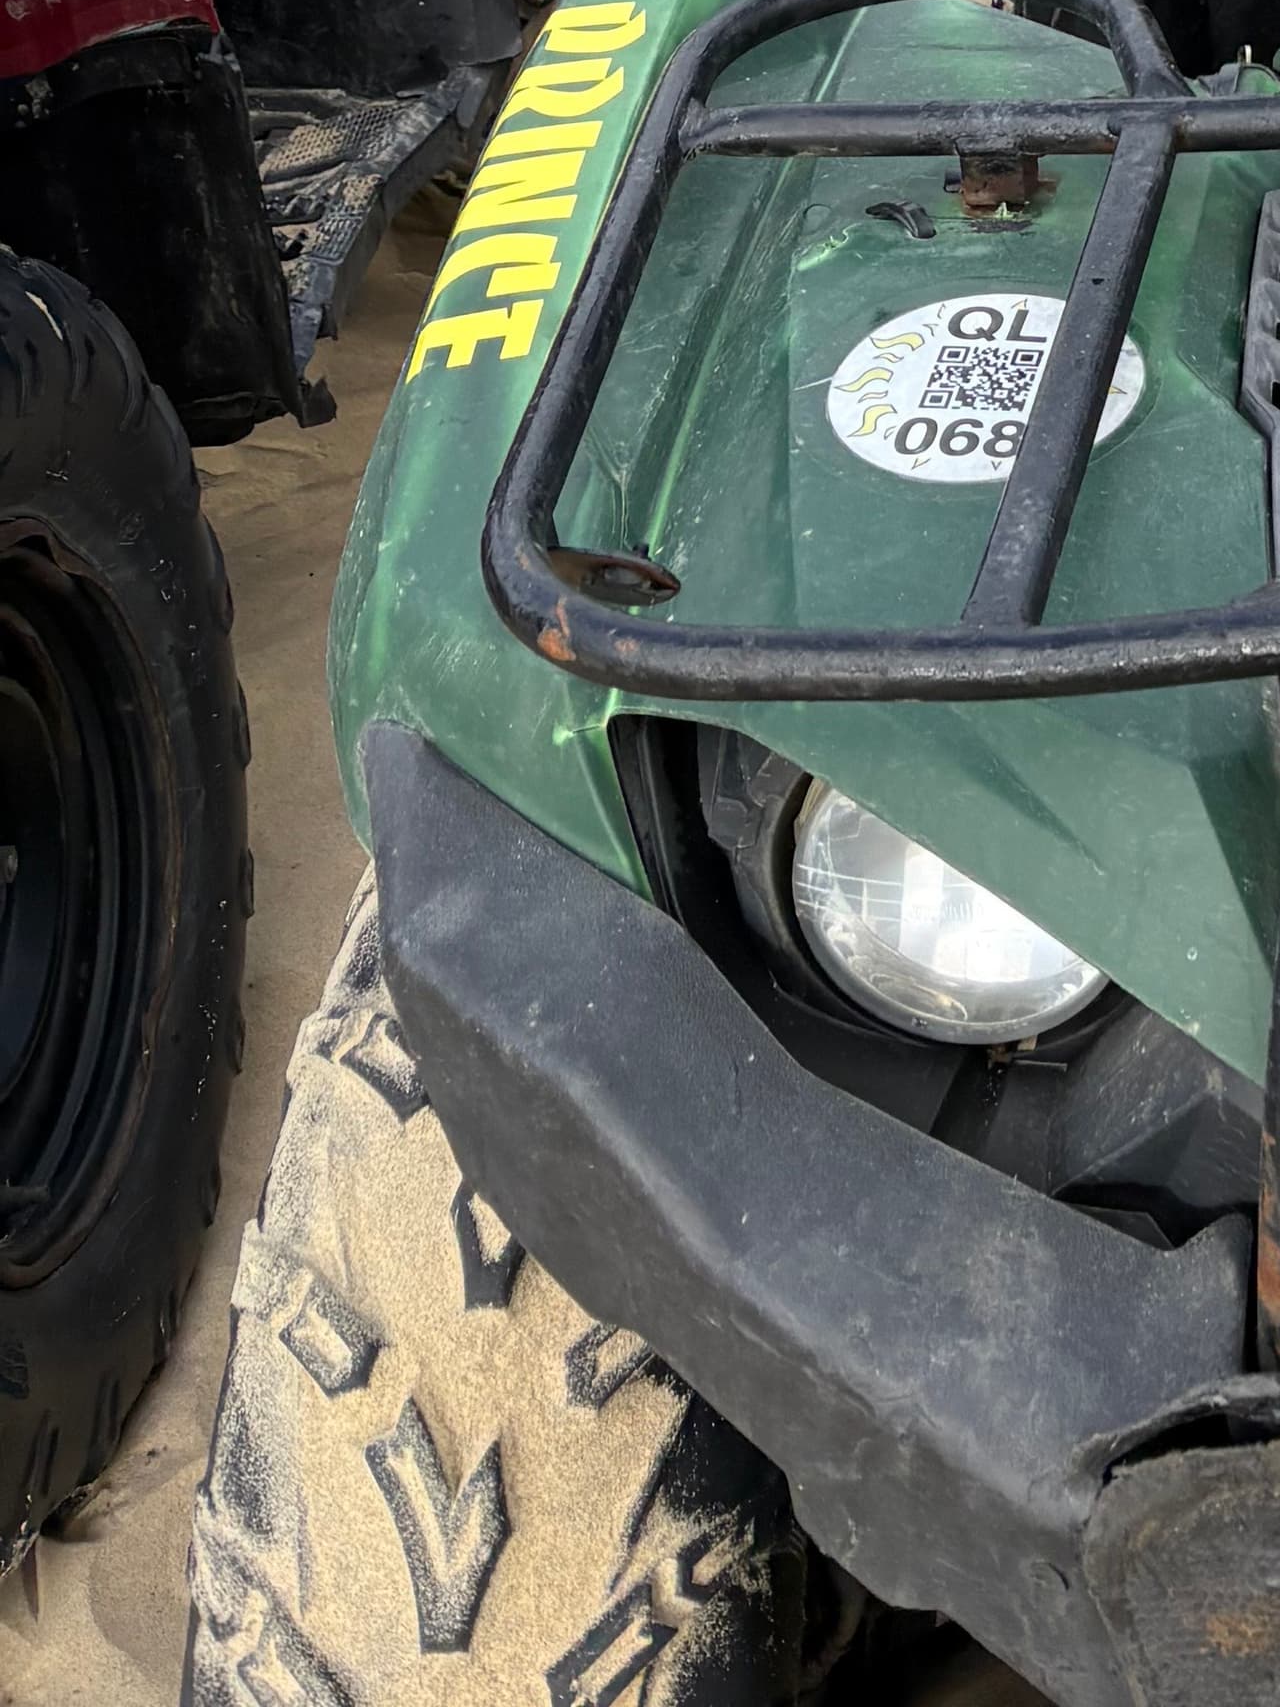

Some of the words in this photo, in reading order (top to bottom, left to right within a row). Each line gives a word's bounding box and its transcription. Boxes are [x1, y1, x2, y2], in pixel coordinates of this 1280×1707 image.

[405, 2, 646, 385] PRINCE
[947, 306, 1048, 344] QL
[894, 417, 1027, 459] 068
